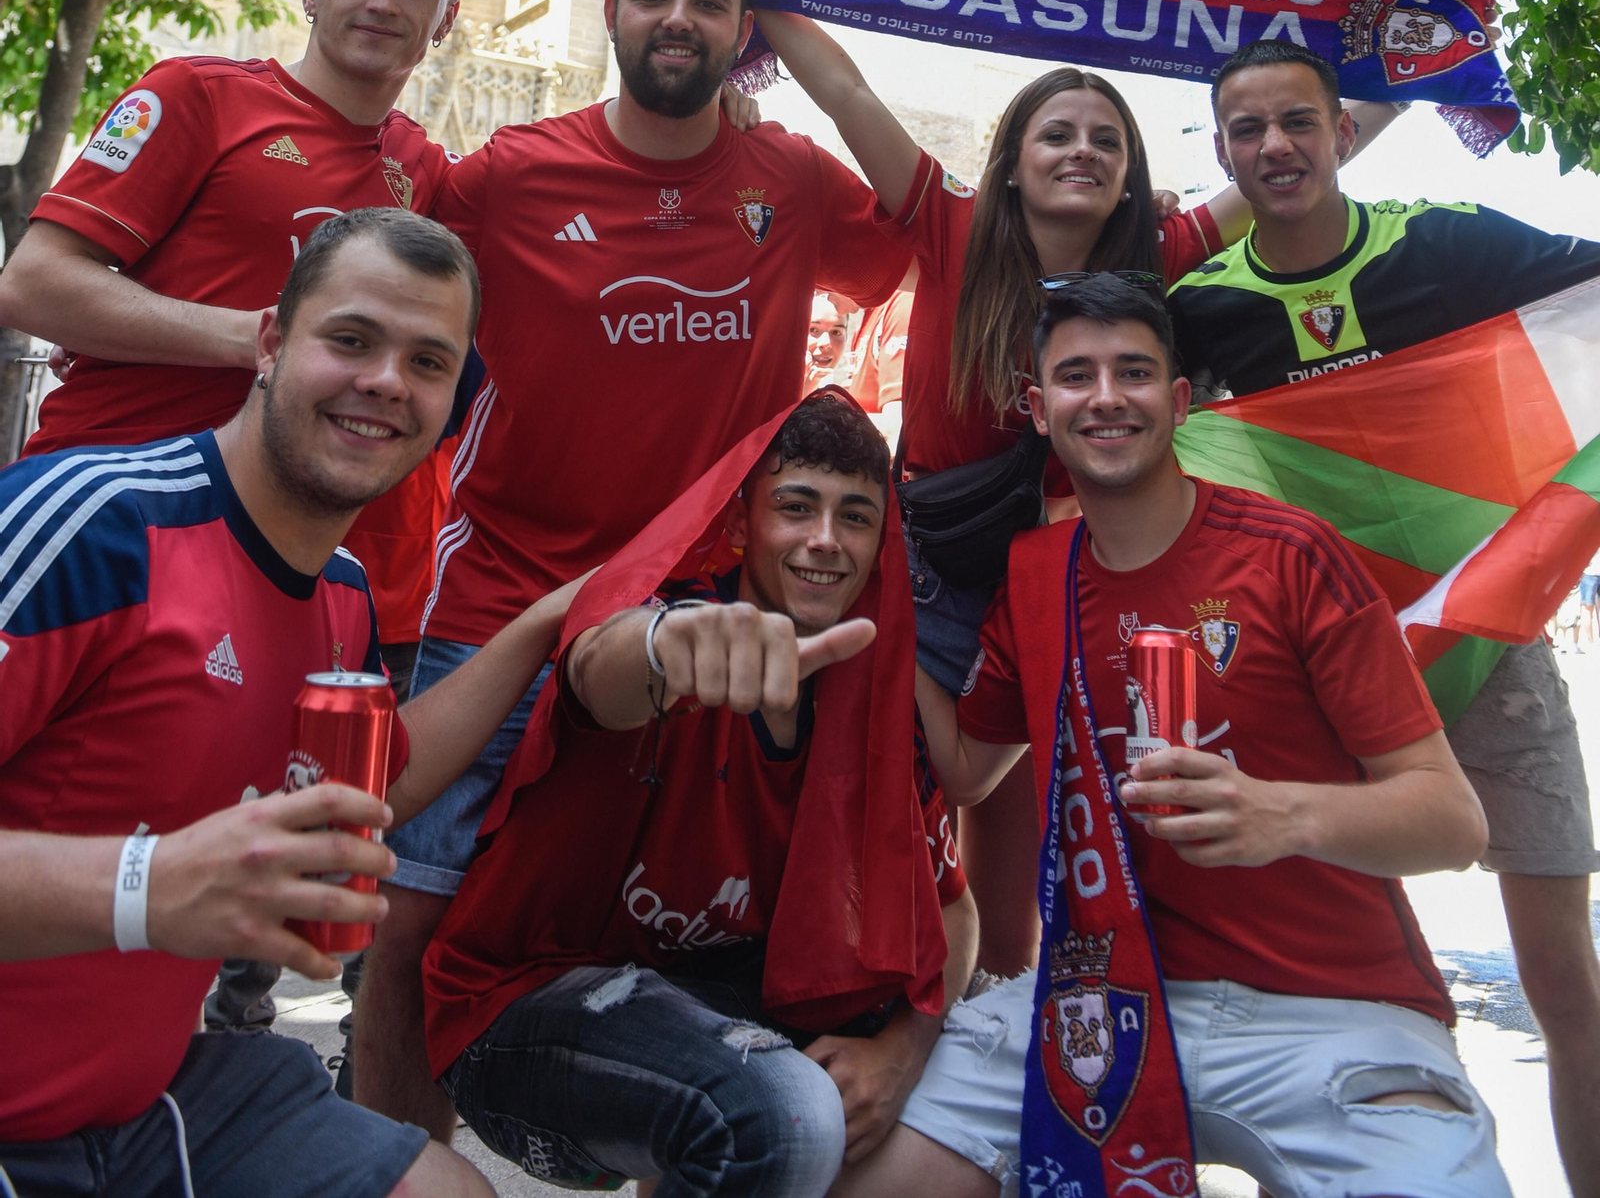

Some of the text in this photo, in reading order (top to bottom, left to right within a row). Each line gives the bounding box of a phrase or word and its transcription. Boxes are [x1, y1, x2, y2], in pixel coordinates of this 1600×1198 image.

[800, 0, 994, 44] CLUB ATLETICO OSASUNA
[262, 148, 309, 166] adidas
[600, 299, 752, 345] verleal
[205, 660, 243, 685] adidas
[1072, 656, 1088, 707] CLUB
[1109, 812, 1140, 911] OSASUNA
[1045, 868, 1055, 924] CLUB
